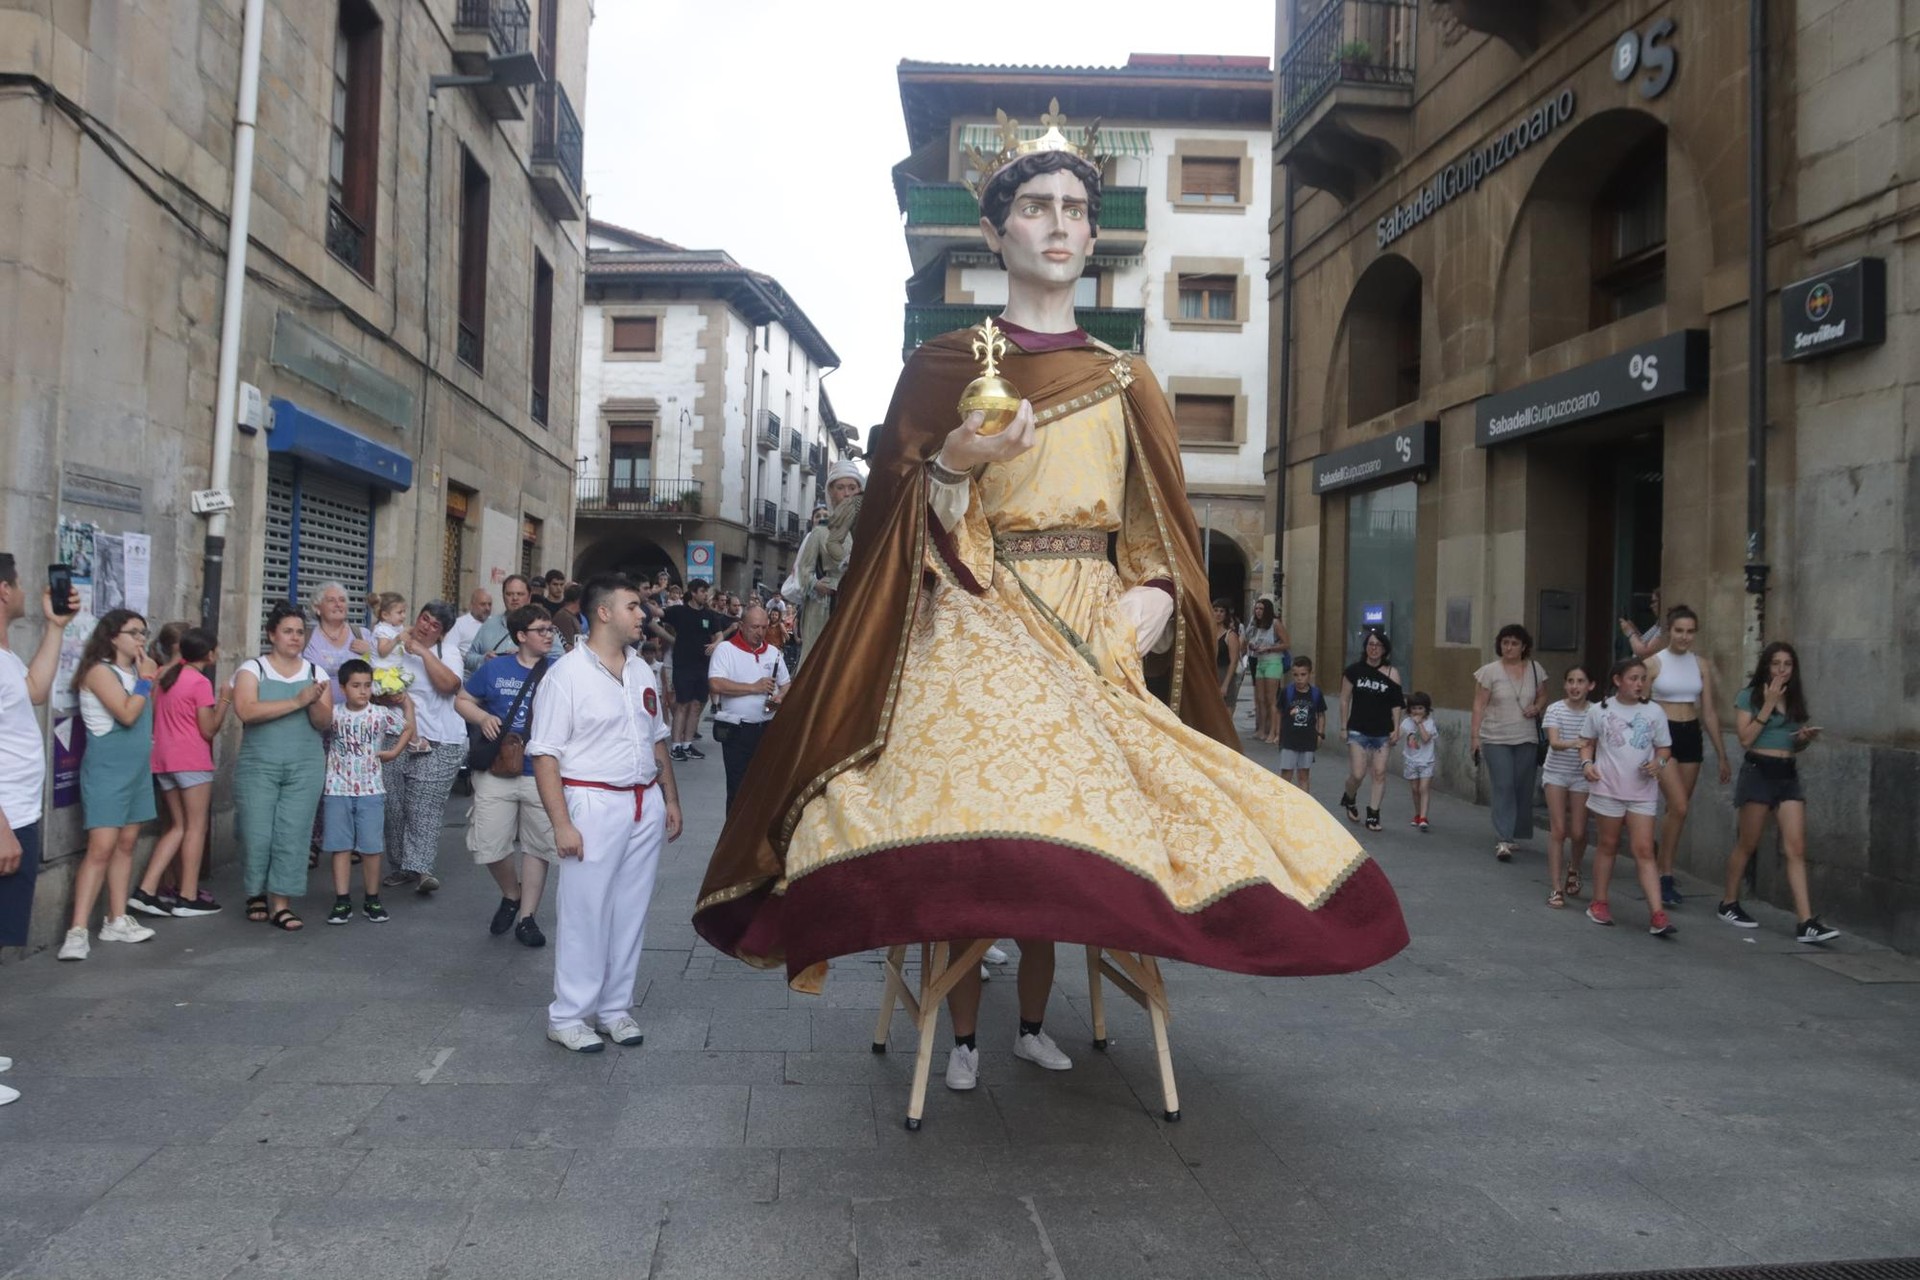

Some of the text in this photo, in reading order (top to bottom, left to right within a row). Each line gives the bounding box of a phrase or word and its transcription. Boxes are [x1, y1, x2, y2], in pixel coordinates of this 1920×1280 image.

[1377, 90, 1573, 248] SabadellGuipuzcoano
[1489, 390, 1600, 436] SabadellGuipuzcoano
[1357, 679, 1388, 692] LADY
